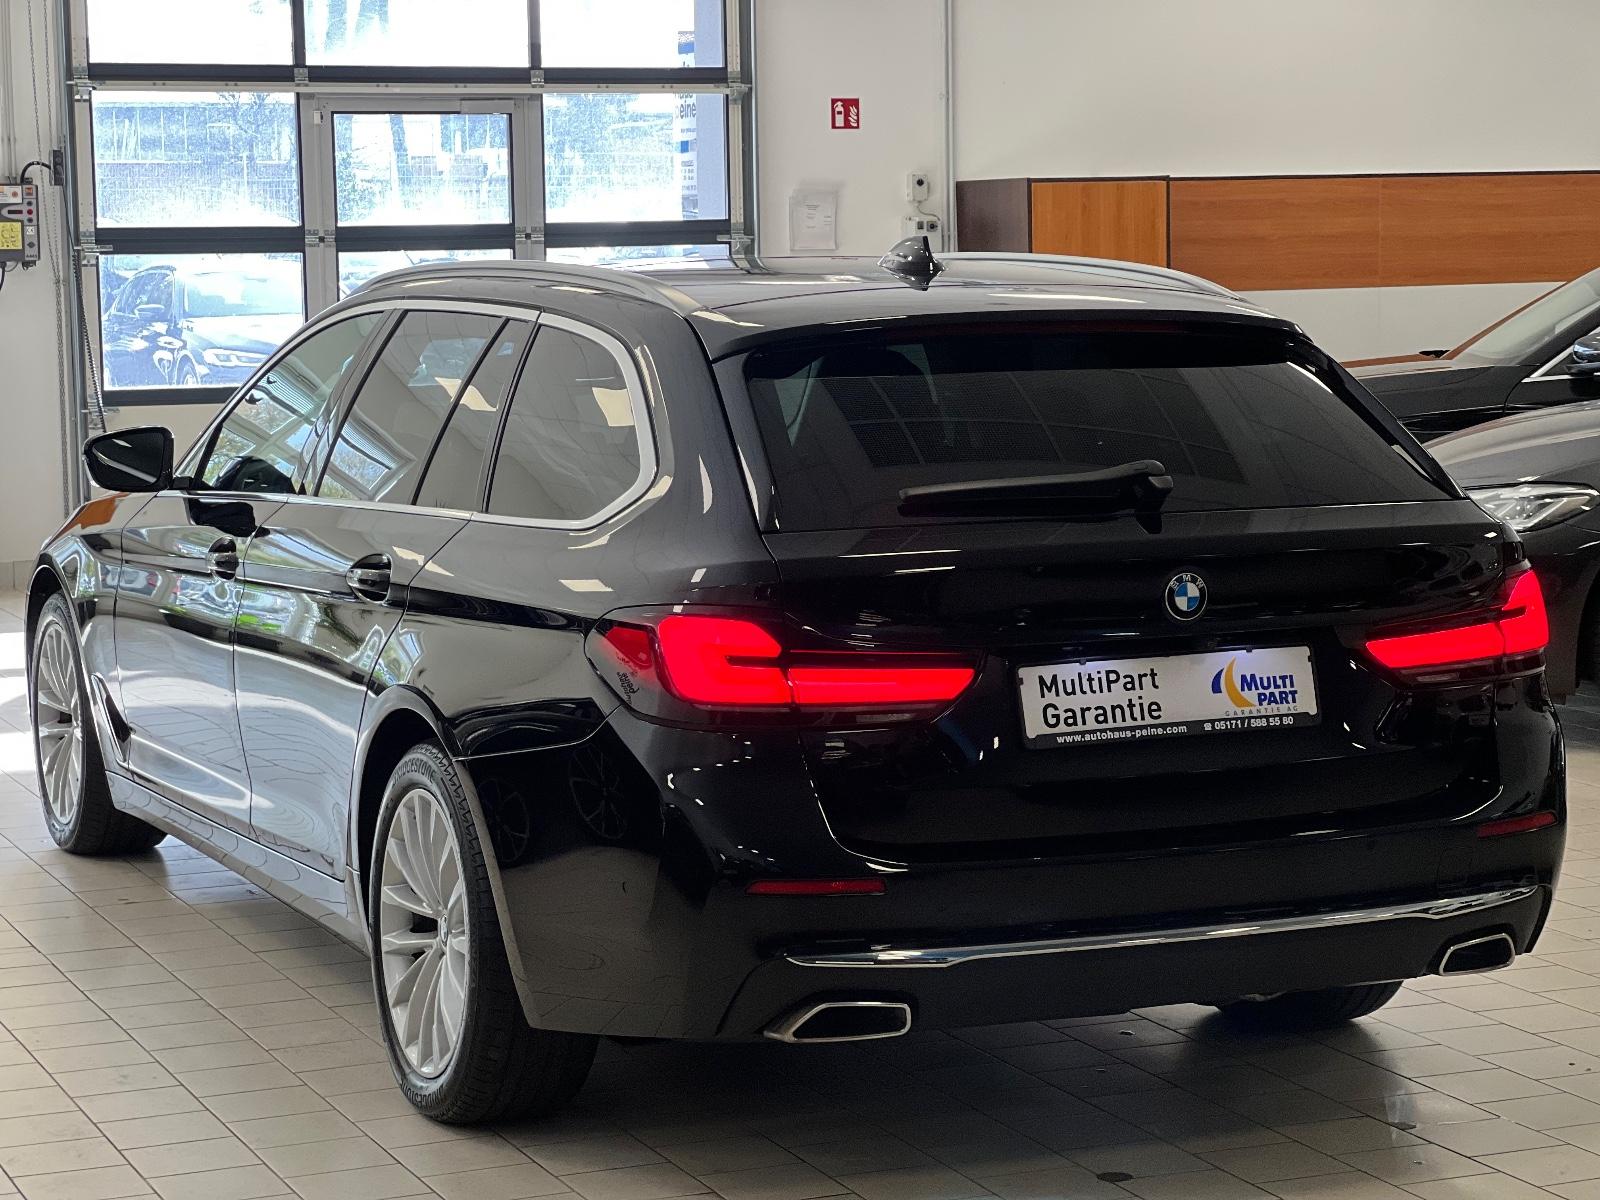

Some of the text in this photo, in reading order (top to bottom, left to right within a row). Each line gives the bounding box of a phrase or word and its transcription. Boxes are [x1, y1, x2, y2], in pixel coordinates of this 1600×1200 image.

[1170, 574, 1205, 591] BMW
[1038, 668, 1159, 699] MultiPart
[1257, 690, 1298, 707] PART
[1042, 695, 1162, 729] Garantie
[1225, 707, 1281, 717] GARANTIE
[1214, 720, 1242, 730] 05171
[1250, 718, 1268, 728] 588
[1269, 717, 1281, 726] 55
[1282, 716, 1294, 725] 80
[1056, 725, 1188, 744] www.autohaus-peine.com
